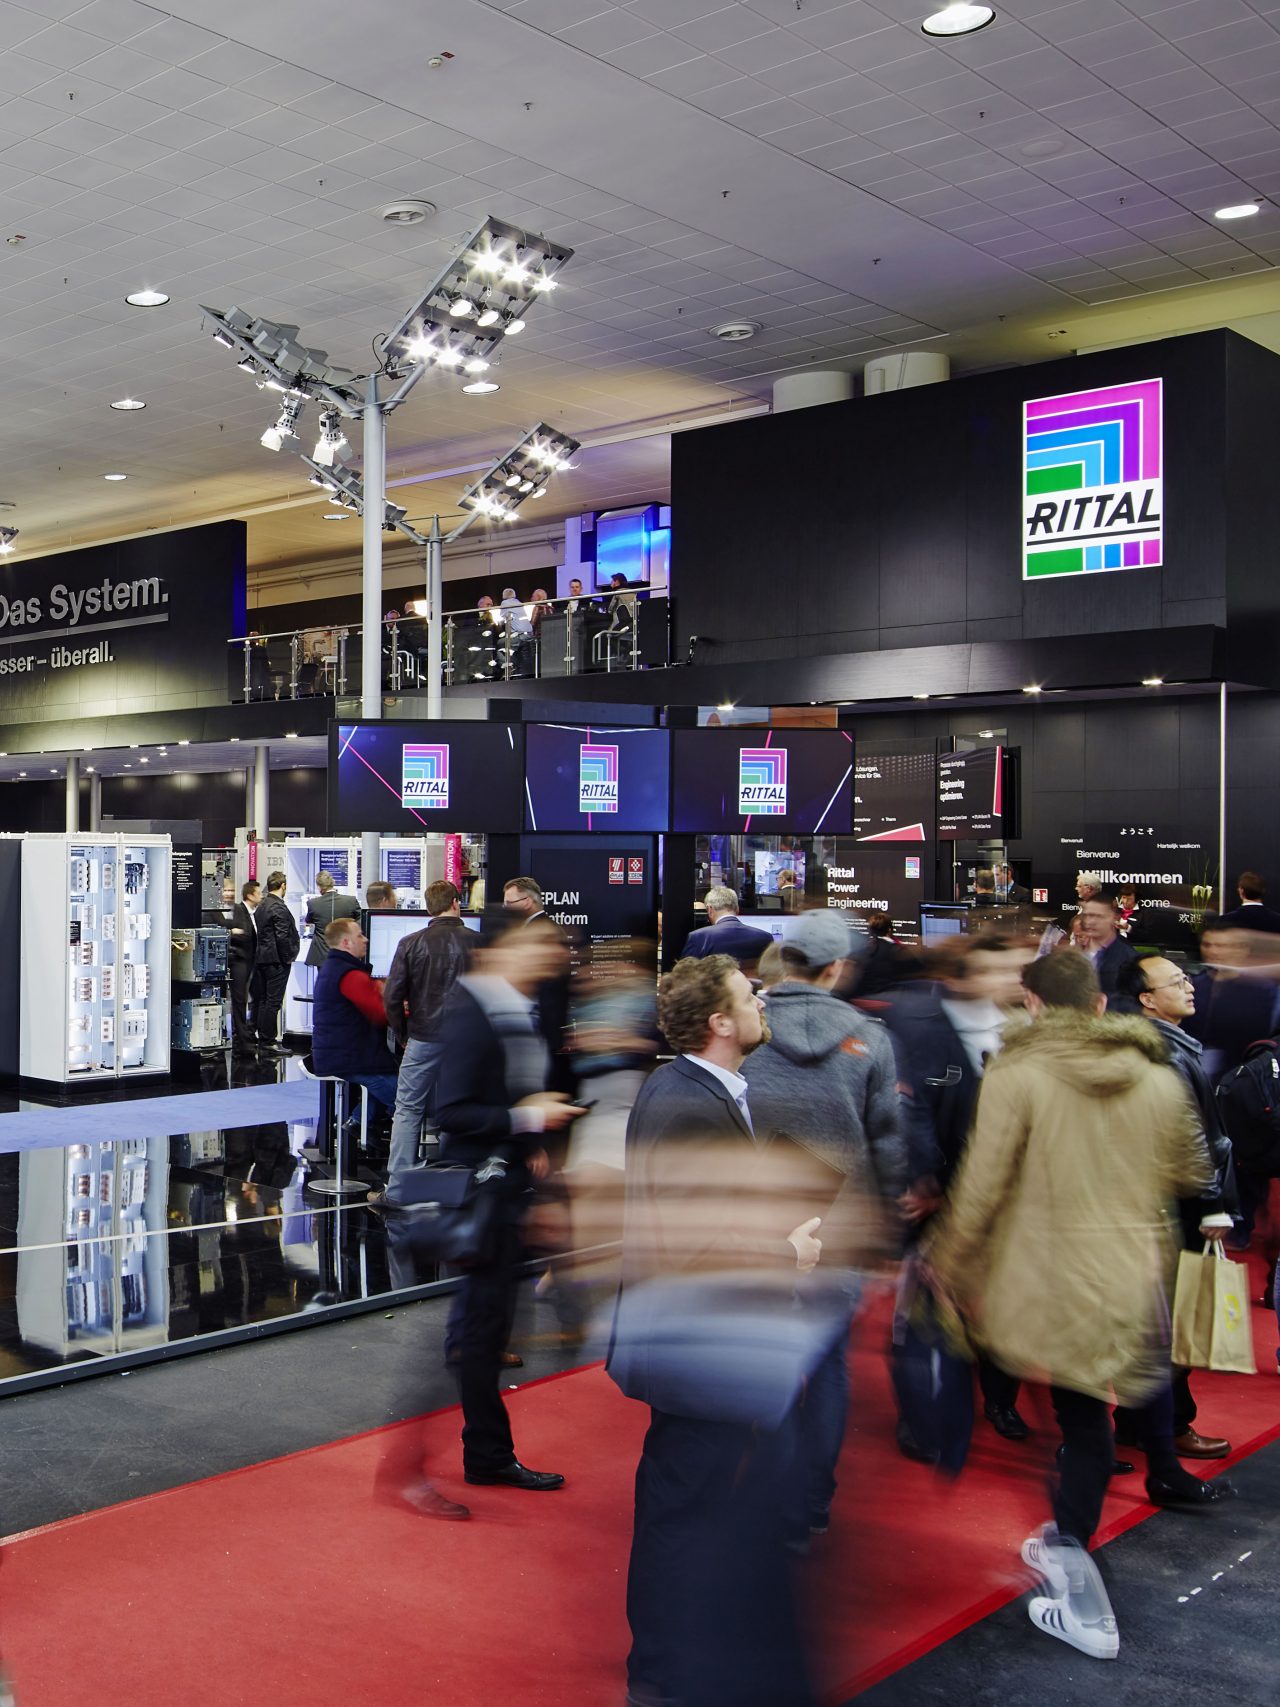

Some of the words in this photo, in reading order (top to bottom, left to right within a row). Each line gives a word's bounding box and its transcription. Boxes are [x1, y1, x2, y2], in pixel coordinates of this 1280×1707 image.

[1026, 488, 1160, 536] RITTAL
[49, 577, 169, 625] System.
[51, 641, 114, 669] überall.
[404, 781, 448, 794] RITTAL
[581, 784, 617, 798] RITTAL
[940, 779, 965, 790] Engineering
[740, 787, 785, 800] RITTAL
[1120, 827, 1154, 836] ようこそ
[1076, 850, 1120, 859] Bienvenue
[827, 867, 855, 878] Rittal
[827, 882, 860, 893] Power
[827, 897, 889, 911] Engineering
[1116, 897, 1171, 908] come
[546, 911, 588, 925] atform
